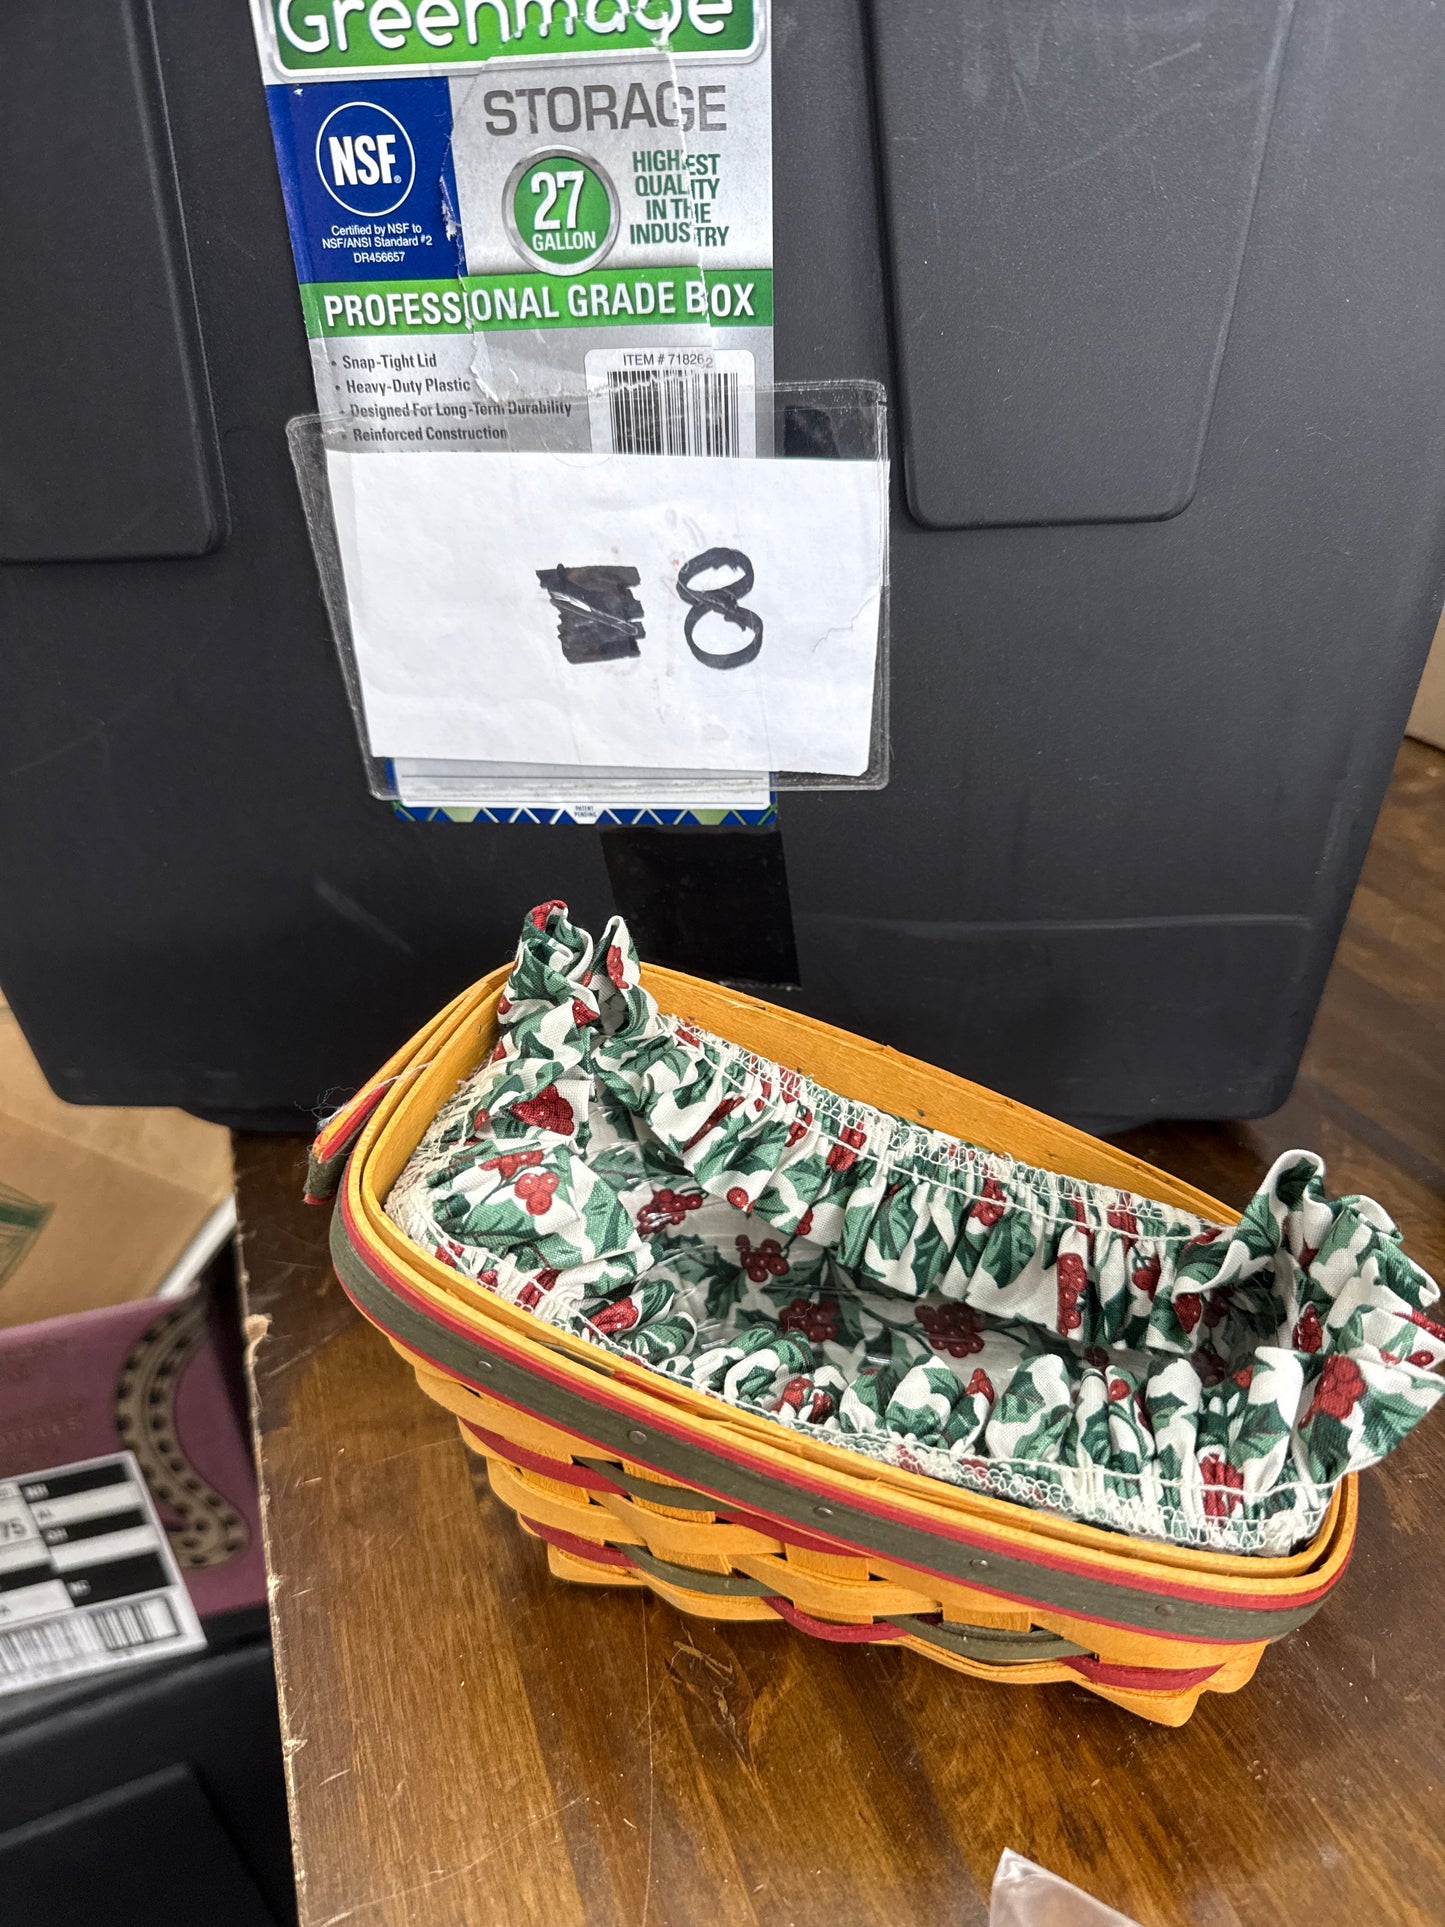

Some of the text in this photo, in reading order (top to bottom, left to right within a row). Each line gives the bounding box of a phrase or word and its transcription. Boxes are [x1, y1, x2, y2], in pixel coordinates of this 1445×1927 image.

[484, 82, 727, 136] STORAGE
[632, 149, 720, 176] HIGHEST
[530, 170, 586, 230] 27
[635, 178, 720, 200] QUALITY
[646, 198, 711, 224] IN THE
[331, 223, 422, 237] Certified by NSF to
[532, 229, 597, 252] GALLON
[630, 222, 729, 247] INDUSTRY
[322, 234, 433, 249] NSF/ANSI Standard #2
[353, 251, 405, 263] DR456657
[324, 281, 755, 328] PROFESSIONAL GRADE BOX
[342, 353, 437, 372] Snap-Tight Lid
[623, 354, 654, 366] ITEM
[657, 354, 665, 365] #
[346, 377, 471, 396] Heavy-Duty Plastic
[350, 400, 572, 420] Designed For Long-Term Durability
[353, 425, 507, 442] Reinforced Construction
[676, 547, 764, 671] 8
